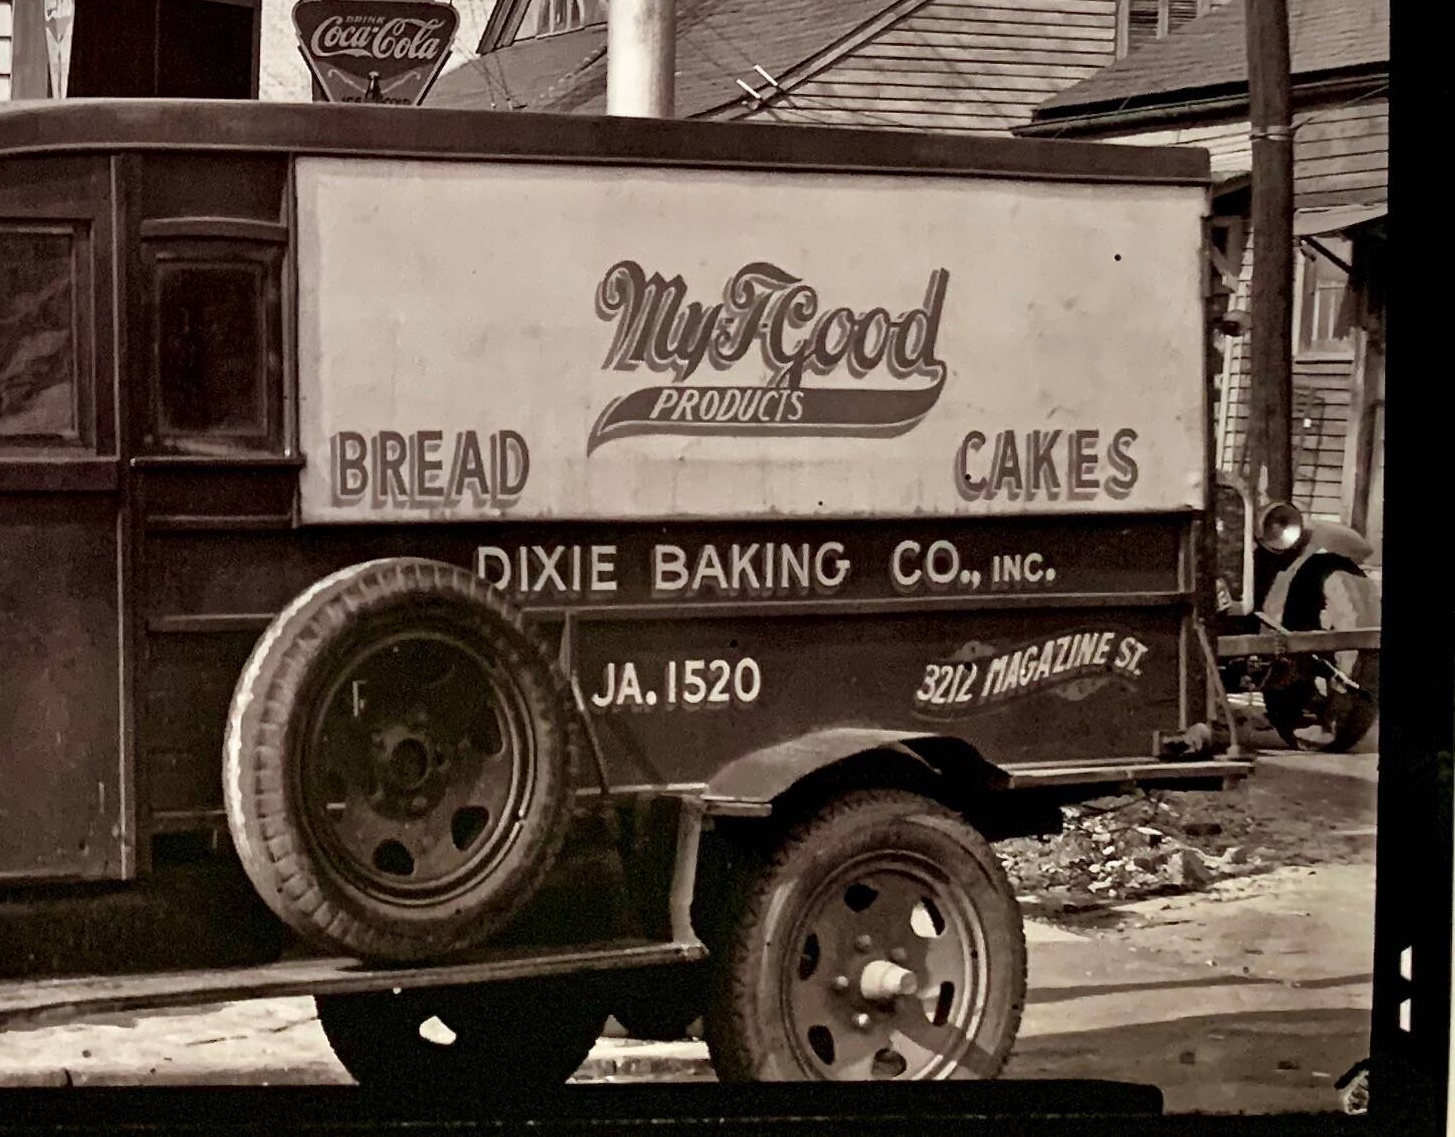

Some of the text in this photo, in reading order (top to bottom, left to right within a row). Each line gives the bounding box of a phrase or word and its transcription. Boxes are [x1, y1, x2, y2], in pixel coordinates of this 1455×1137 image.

[310, 15, 446, 59] Coca-Cola
[346, 15, 386, 24] DRINK
[649, 388, 804, 423] PRODUCTS
[331, 428, 532, 510] BREAD
[953, 426, 1141, 504] CAKES
[477, 544, 618, 594] DIXIE
[653, 541, 851, 595] BAKING
[991, 553, 1057, 585] INC.
[916, 663, 979, 705] 3212
[980, 631, 1116, 698] MAGAZINE
